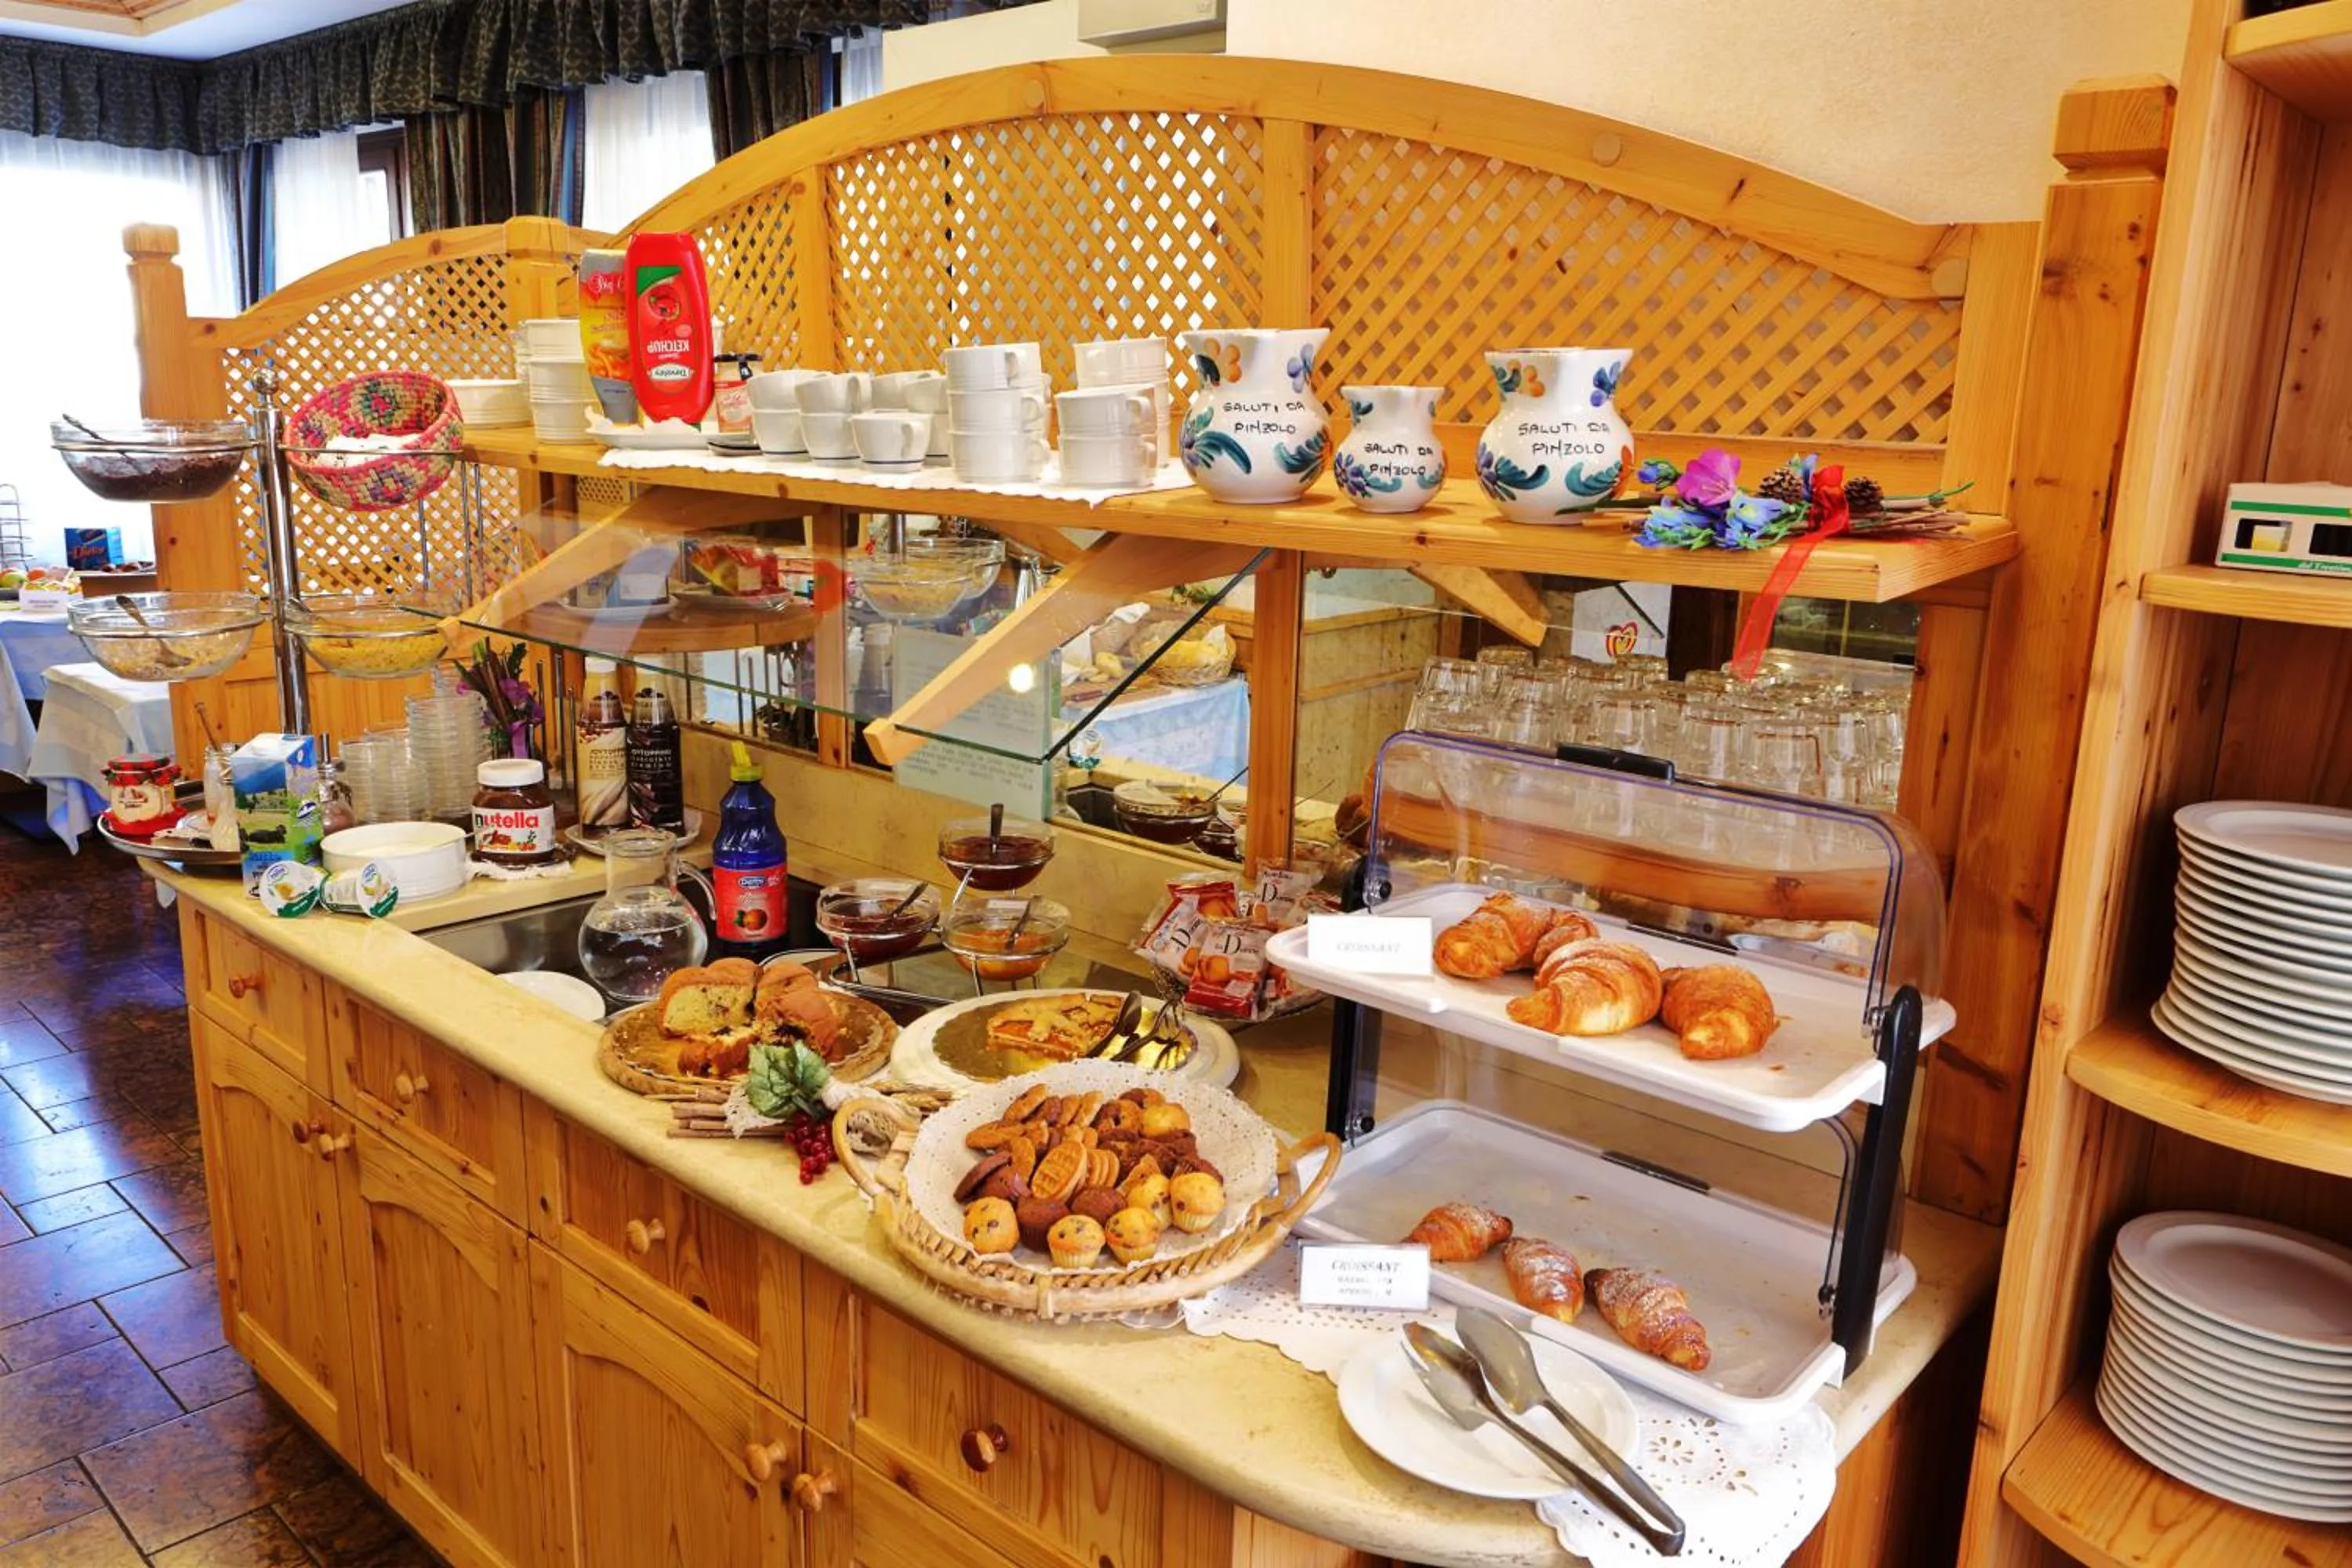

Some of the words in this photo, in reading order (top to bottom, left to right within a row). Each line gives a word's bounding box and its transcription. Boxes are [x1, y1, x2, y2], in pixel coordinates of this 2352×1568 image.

[647, 339, 690, 354] KETCHUP
[1223, 401, 1279, 412] SALUTI
[1234, 419, 1296, 436] PINZOLO
[1518, 422, 1577, 436] SALUTI
[1364, 442, 1409, 455] SALUTI
[1531, 438, 1606, 460] PINZOLO
[1369, 461, 1427, 477] PINZOLO
[475, 811, 539, 829] nutella
